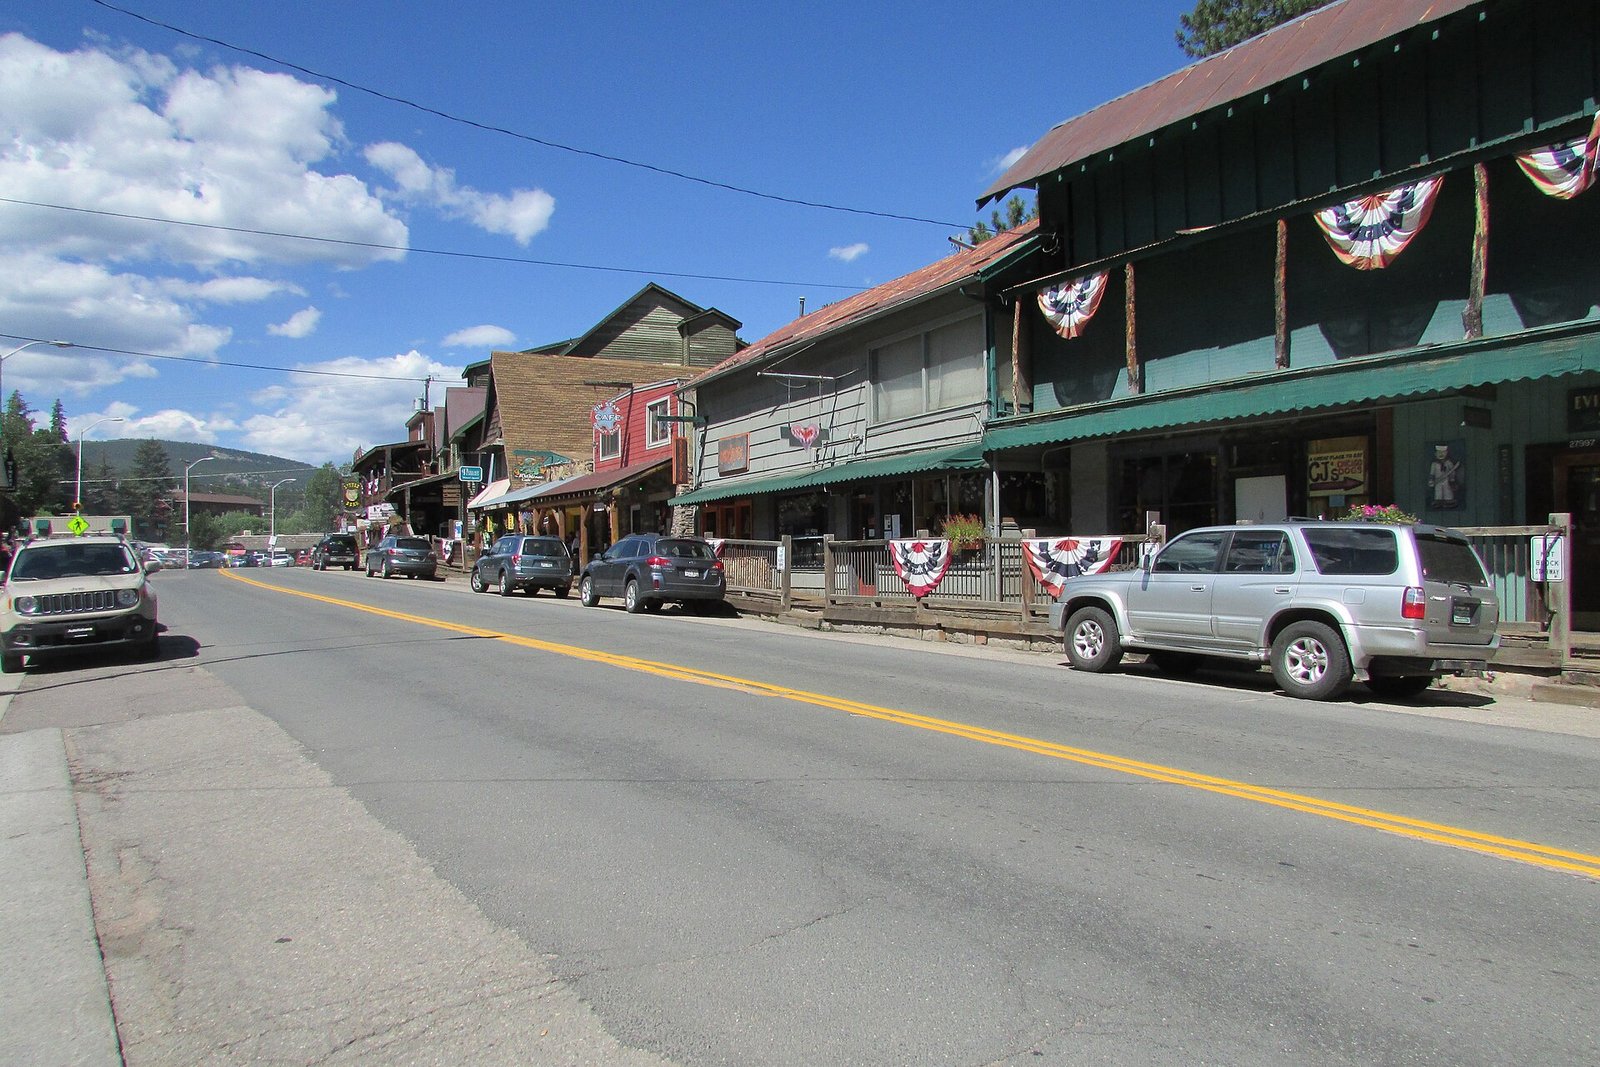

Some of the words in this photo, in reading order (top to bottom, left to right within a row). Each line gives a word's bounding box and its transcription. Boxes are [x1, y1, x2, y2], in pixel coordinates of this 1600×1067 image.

[593, 403, 603, 412] TIN
[605, 402, 621, 413] STAR
[594, 413, 621, 422] CAFE
[1568, 438, 1597, 449] 27997
[1309, 461, 1339, 482] CJ's
[1338, 466, 1362, 475] DOGS
